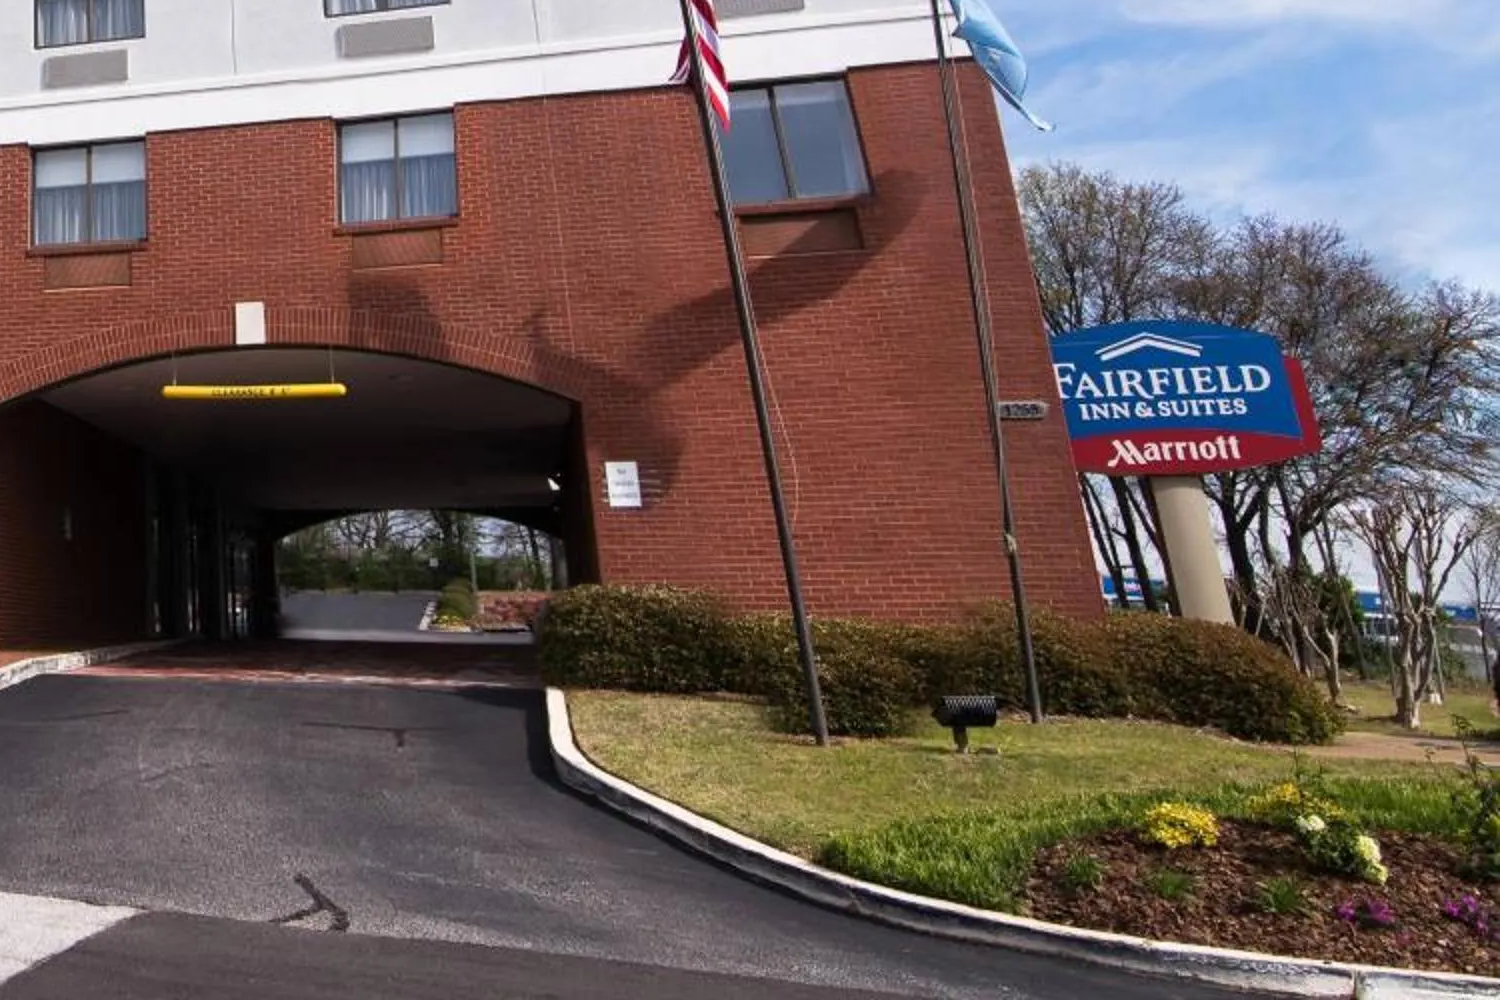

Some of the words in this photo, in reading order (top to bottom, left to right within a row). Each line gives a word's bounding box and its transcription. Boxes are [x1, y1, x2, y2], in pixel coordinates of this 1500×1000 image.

[1052, 362, 1271, 400] FAIRFIELD
[1079, 402, 1129, 421] INN
[1133, 401, 1154, 418] &
[1157, 397, 1247, 417] SUITES
[1107, 435, 1241, 468] Marriott
